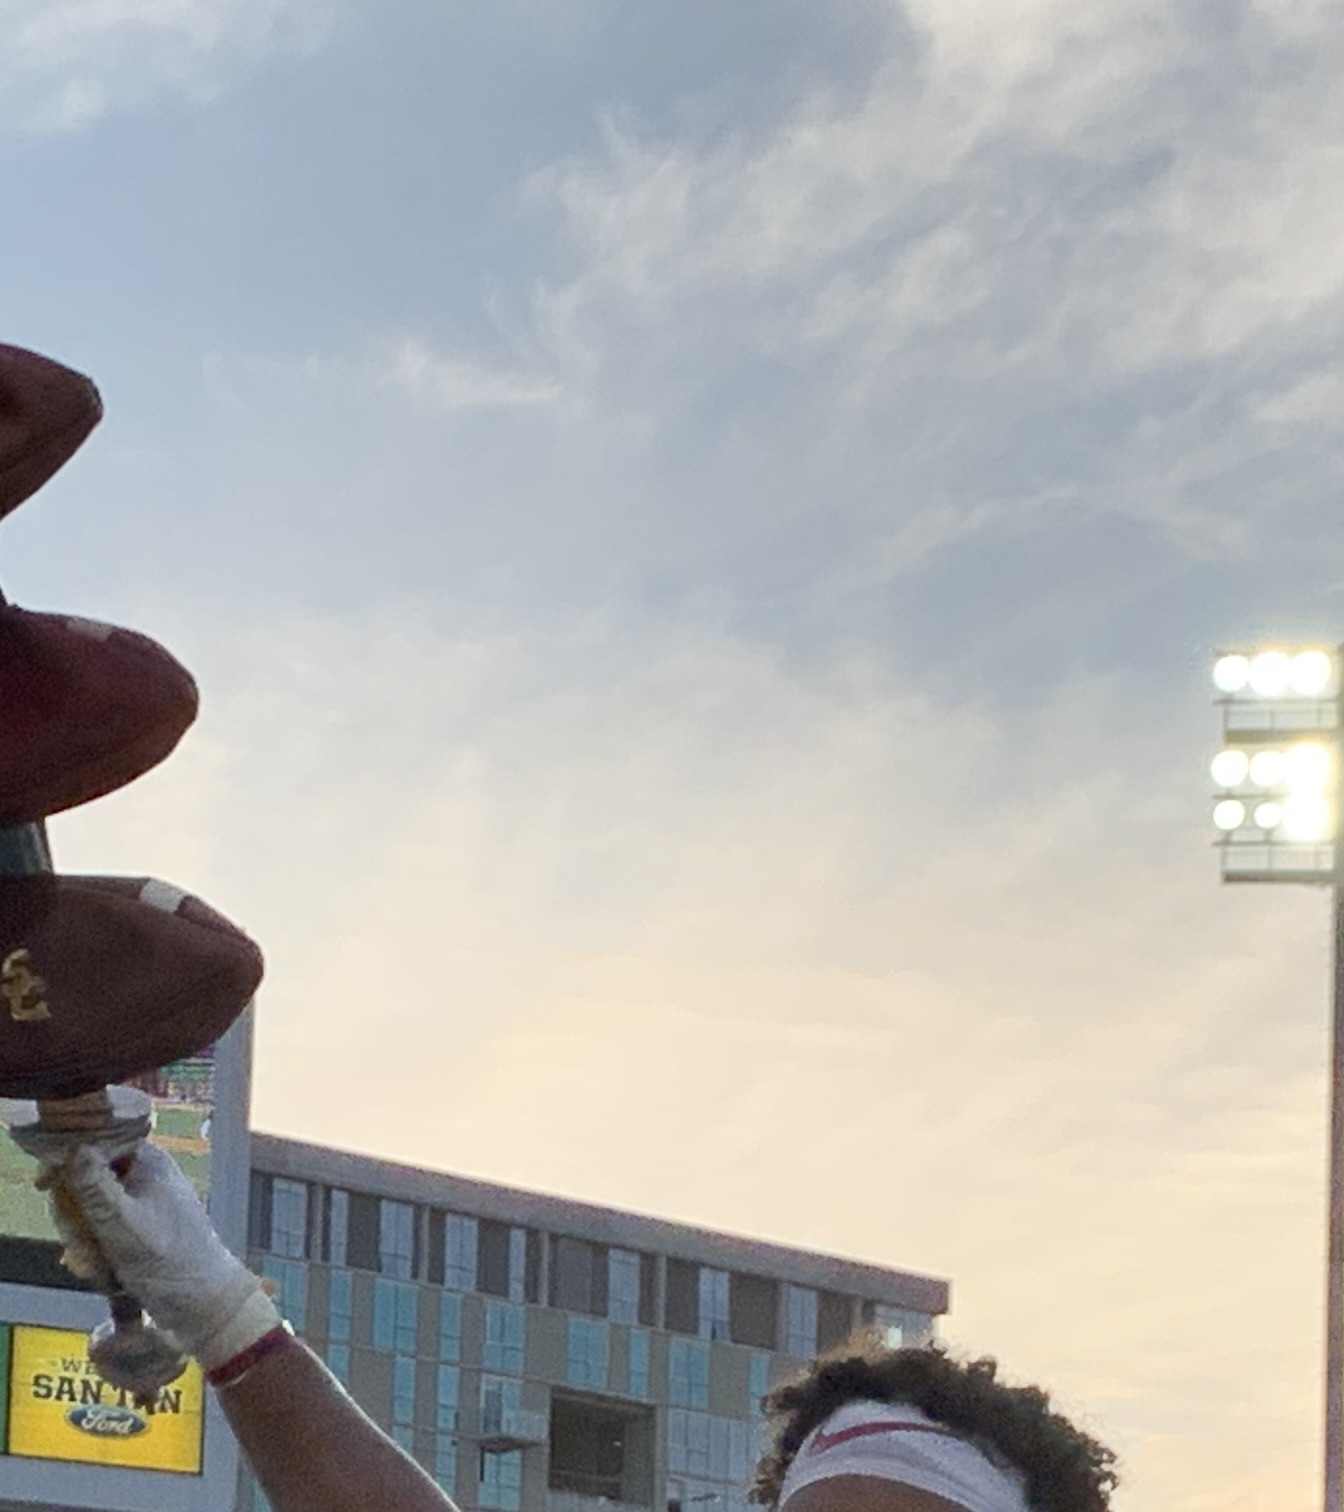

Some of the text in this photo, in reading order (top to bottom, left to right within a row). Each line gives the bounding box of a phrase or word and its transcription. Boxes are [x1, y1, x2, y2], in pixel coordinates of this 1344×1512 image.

[61, 1358, 96, 1376] WE
[32, 1373, 103, 1404] SAN
[80, 1408, 134, 1435] Ford
